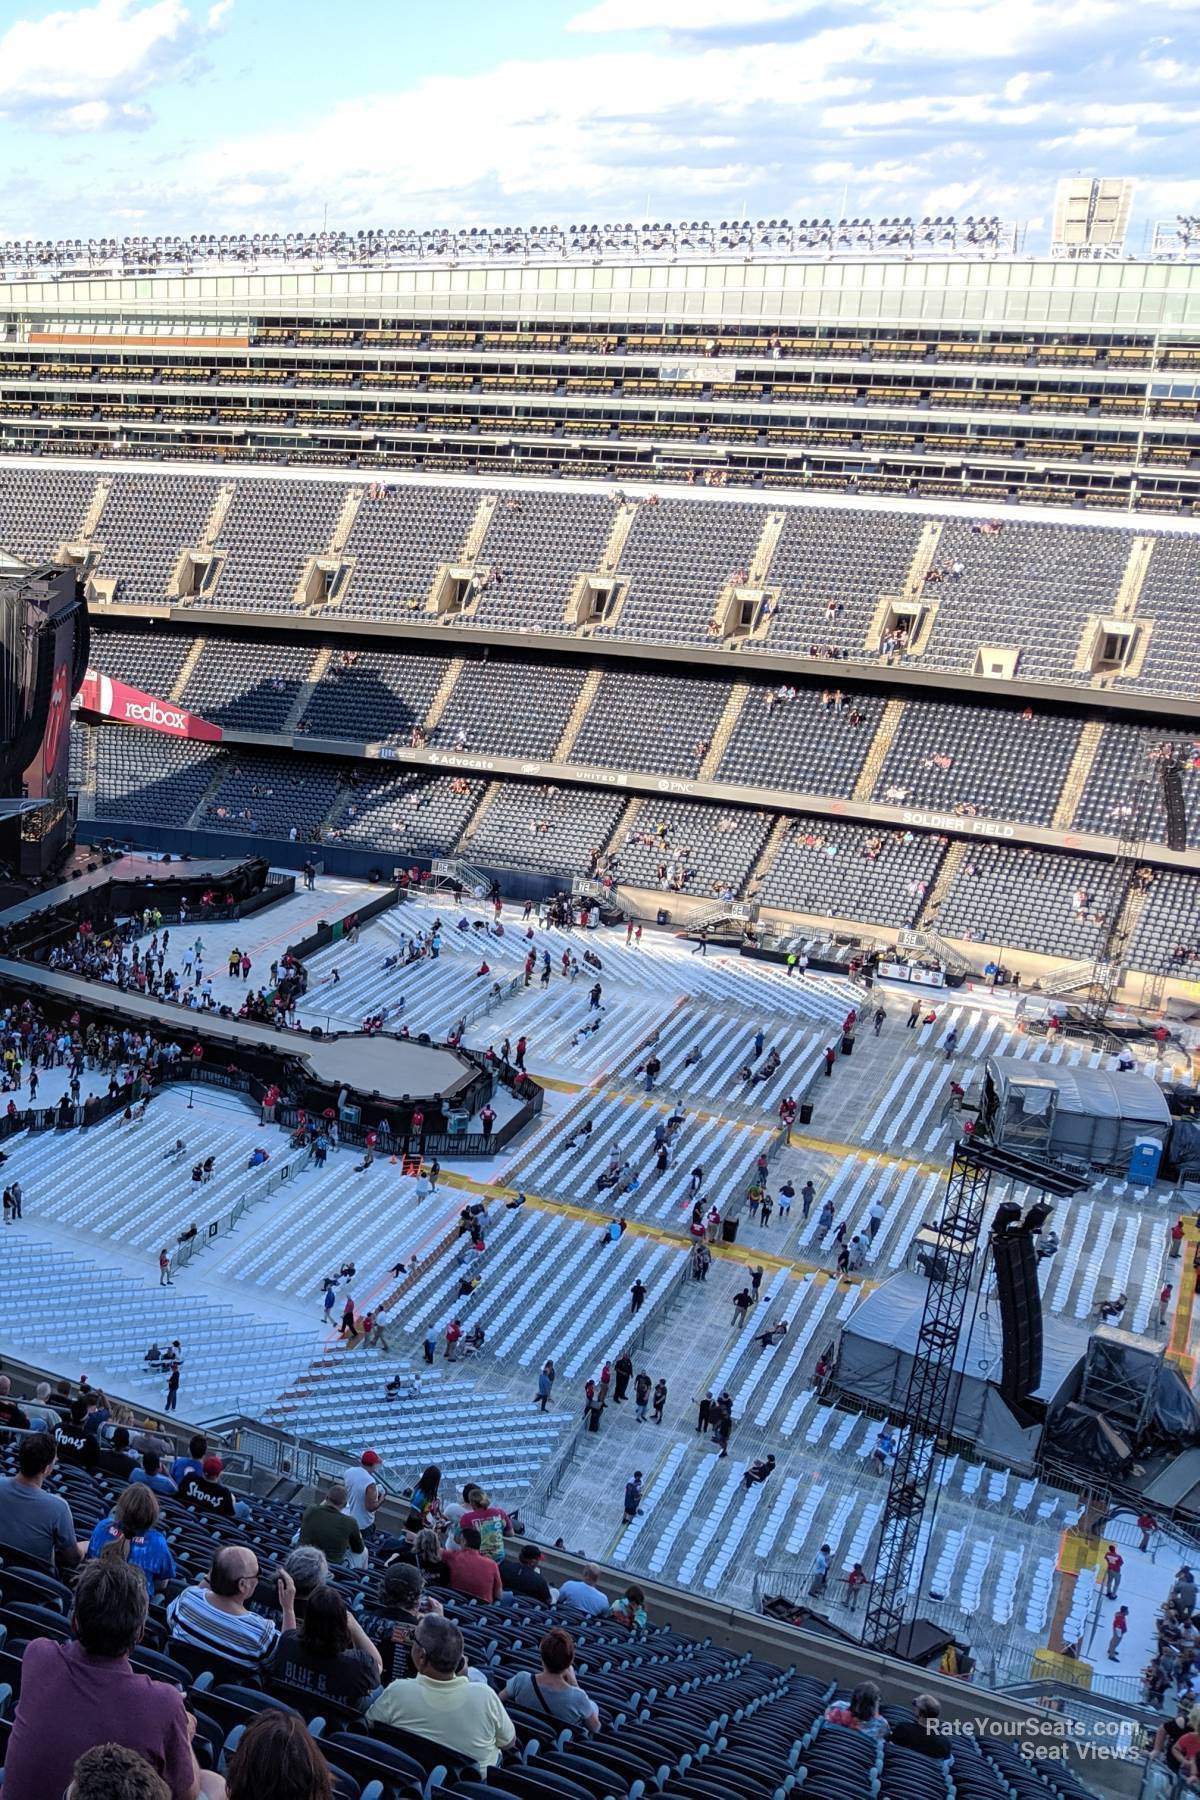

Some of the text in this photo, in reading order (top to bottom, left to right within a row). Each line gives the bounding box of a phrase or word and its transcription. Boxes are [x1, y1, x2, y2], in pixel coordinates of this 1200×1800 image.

[125, 702, 186, 730] redbox
[440, 755, 494, 770] Advocate
[576, 771, 616, 783] UNITED
[670, 783, 694, 793] PNC
[902, 812, 1015, 838] SOLDIER FIELD
[732, 905, 743, 916] 6E
[905, 934, 916, 945] 5E
[55, 1427, 87, 1450] Stones
[186, 1481, 224, 1508] Stones
[285, 1660, 315, 1687] BLUE
